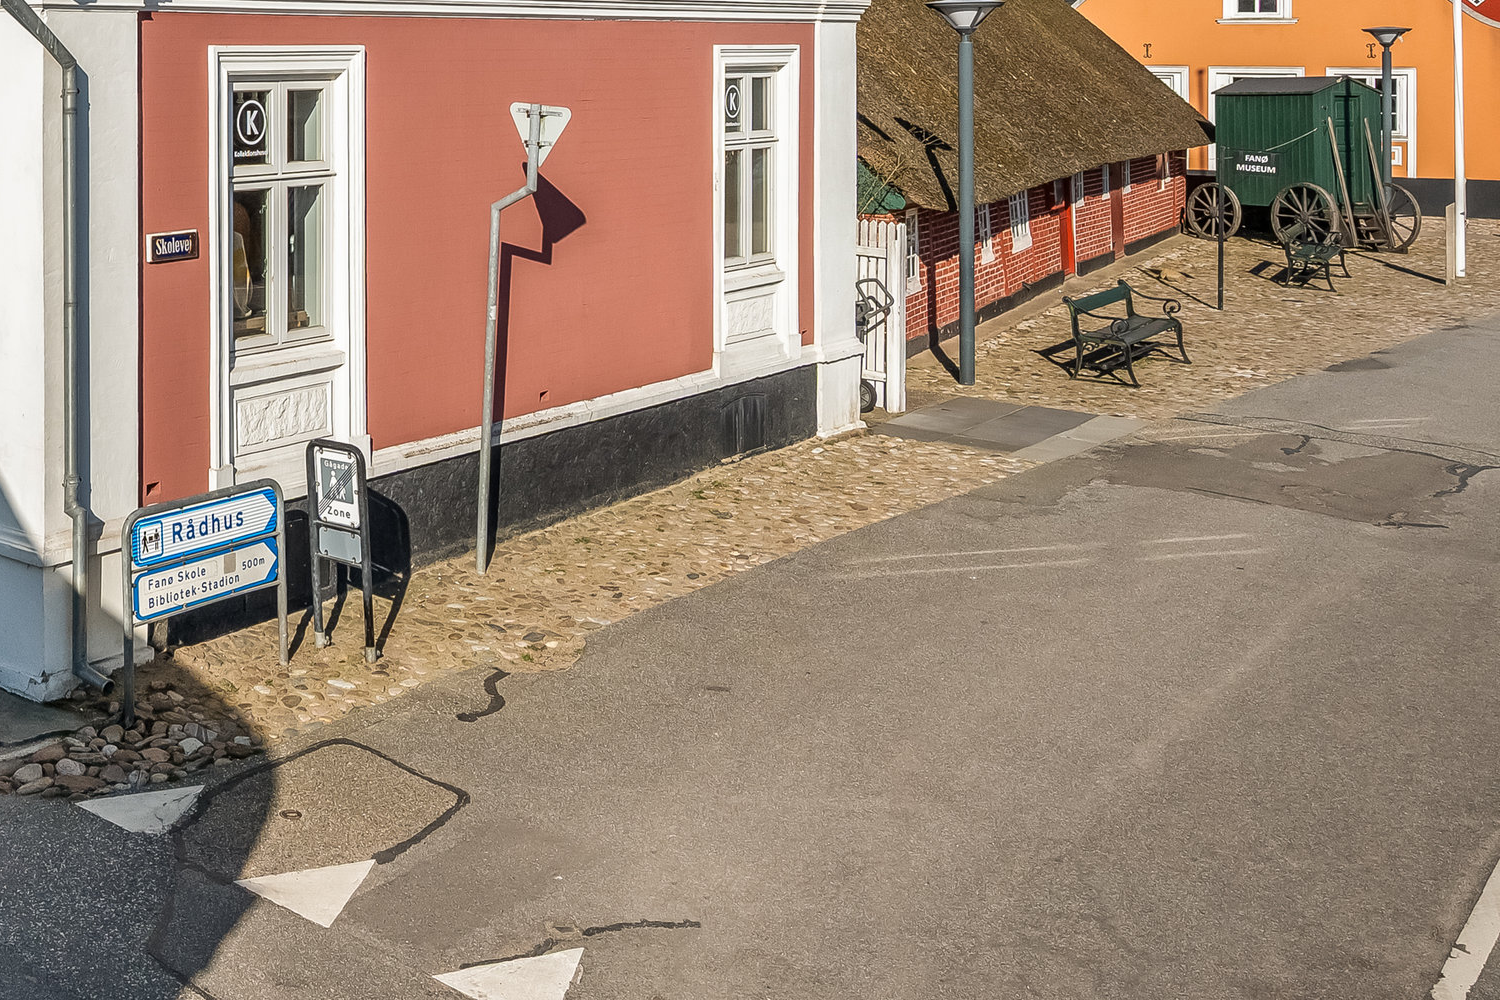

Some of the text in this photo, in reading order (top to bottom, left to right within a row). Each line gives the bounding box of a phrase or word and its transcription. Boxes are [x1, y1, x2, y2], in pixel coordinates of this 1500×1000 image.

[729, 92, 737, 111] K
[246, 110, 259, 135] K
[1245, 154, 1269, 163] FANØ
[1236, 164, 1276, 174] MUSEUM
[155, 235, 192, 256] Skolevej
[327, 505, 351, 519] Zone
[172, 511, 244, 544] Rådhus
[241, 556, 266, 571] 500m
[148, 566, 207, 591] Fanø Skole
